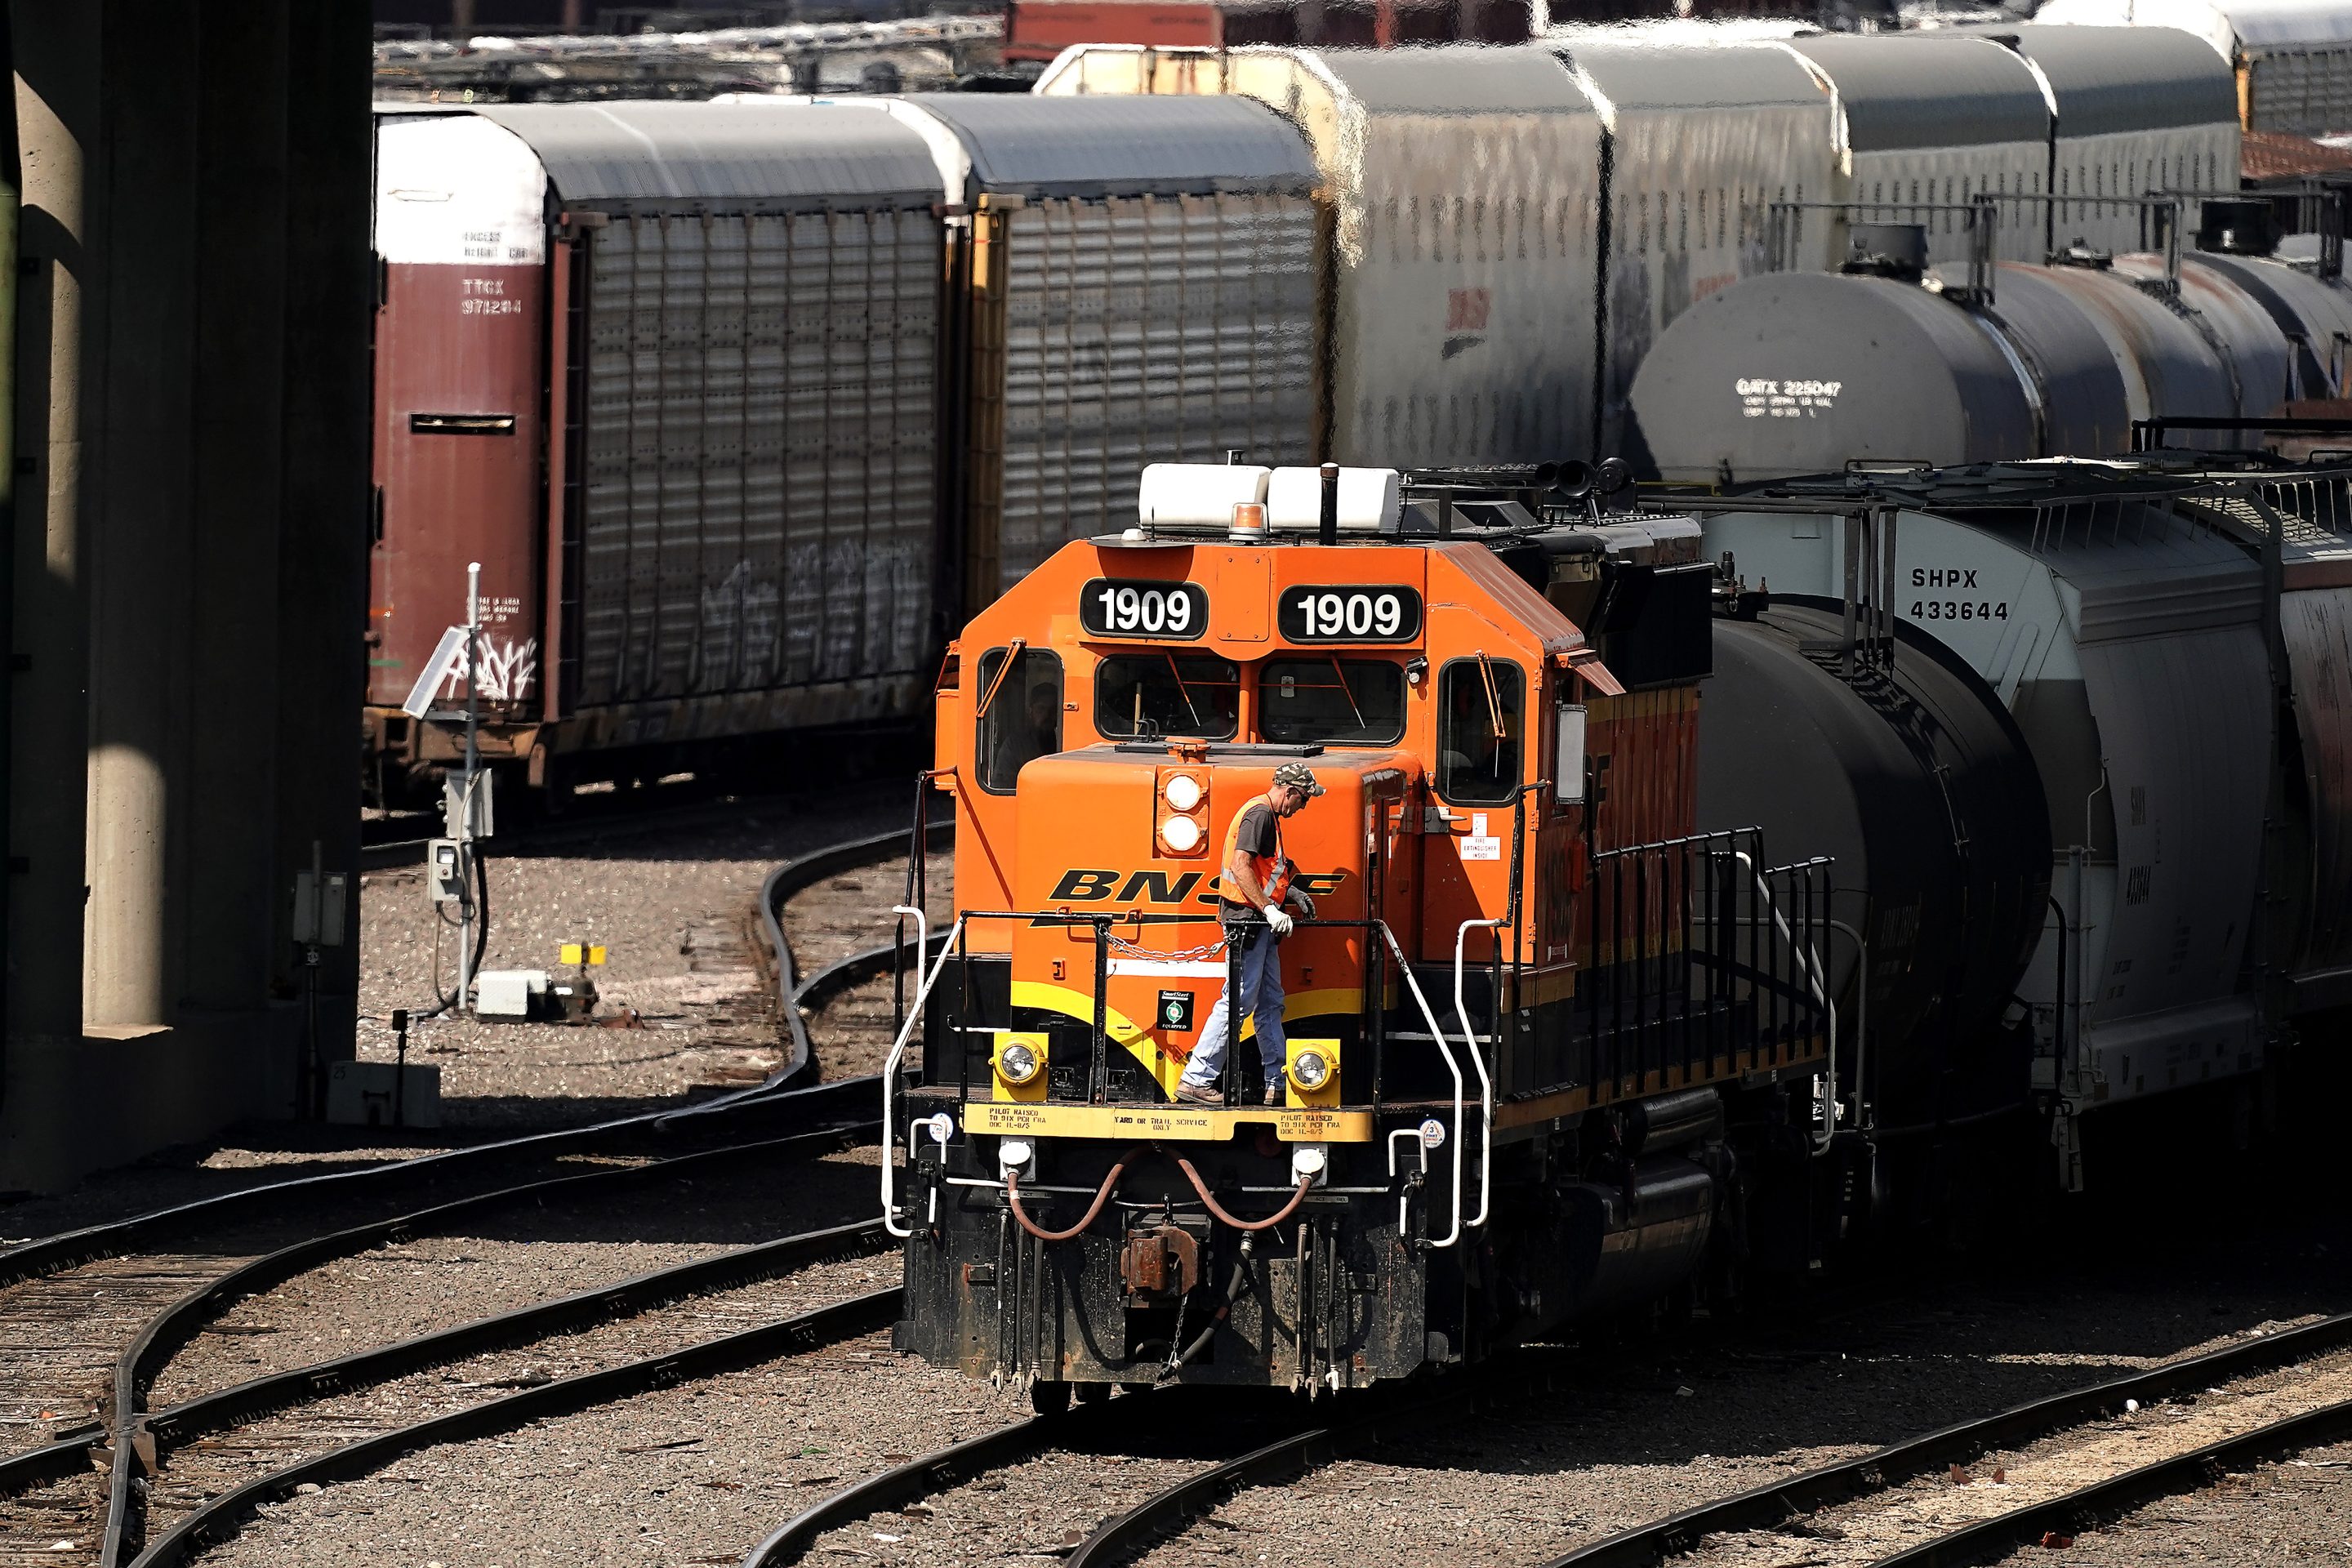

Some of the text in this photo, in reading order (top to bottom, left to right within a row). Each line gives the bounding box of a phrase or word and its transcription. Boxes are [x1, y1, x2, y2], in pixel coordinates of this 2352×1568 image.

[1912, 568, 1978, 589] SHPX
[1098, 587, 1191, 632] 1909
[1297, 594, 1401, 635] 1909
[1910, 600, 2008, 621] 433644
[1047, 869, 1347, 904] BNF
[989, 1107, 1039, 1116] PILOT RAISED
[1114, 1116, 1134, 1125] YARD
[1176, 1119, 1208, 1127] SERVICE
